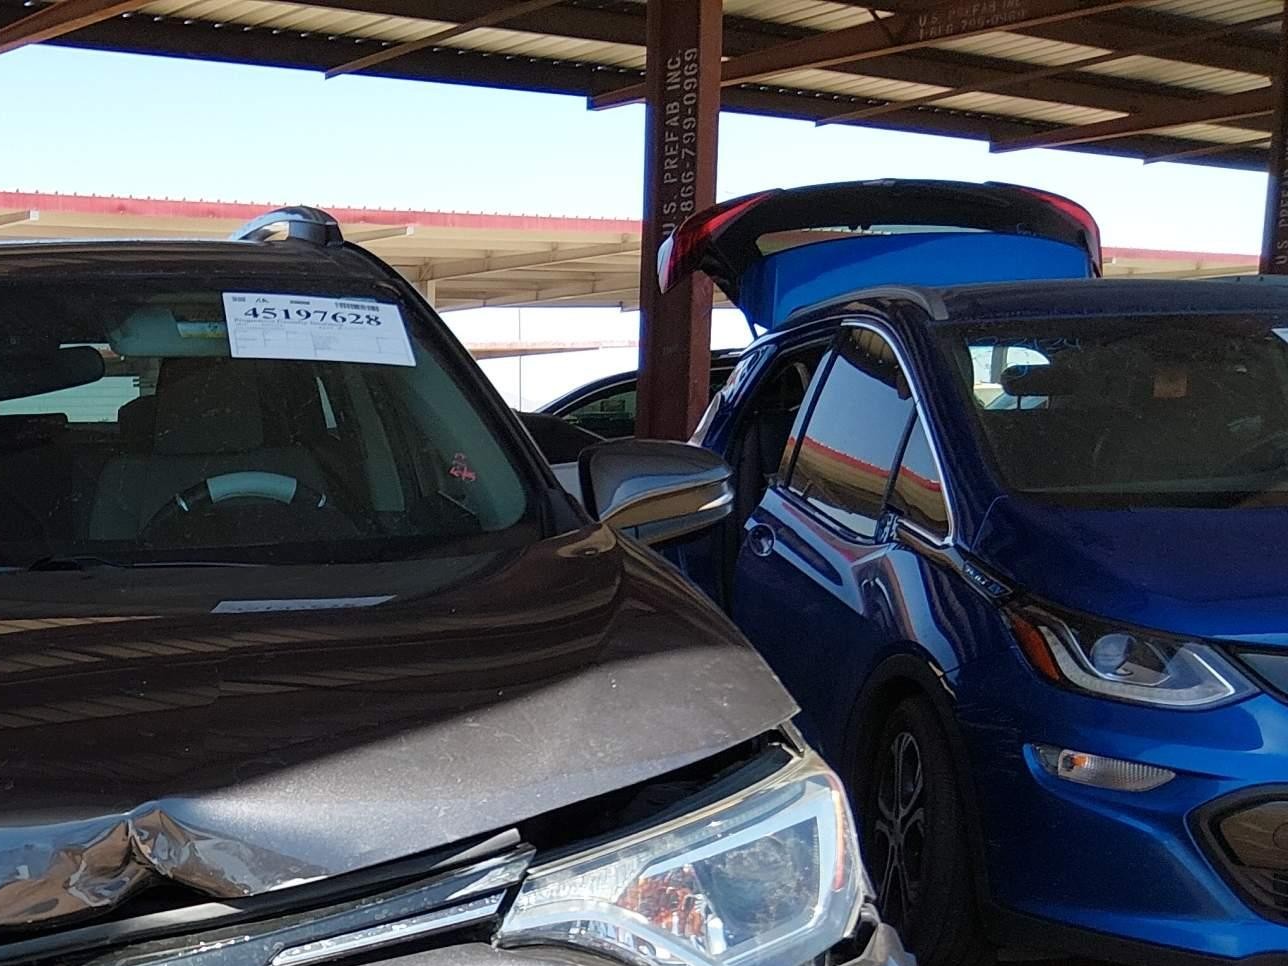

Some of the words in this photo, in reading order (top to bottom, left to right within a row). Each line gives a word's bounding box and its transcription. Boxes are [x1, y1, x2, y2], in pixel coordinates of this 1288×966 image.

[666, 49, 683, 92] INC.
[663, 101, 681, 184] PREFAB
[662, 194, 679, 236] U.S.
[243, 306, 383, 328] 45197628
